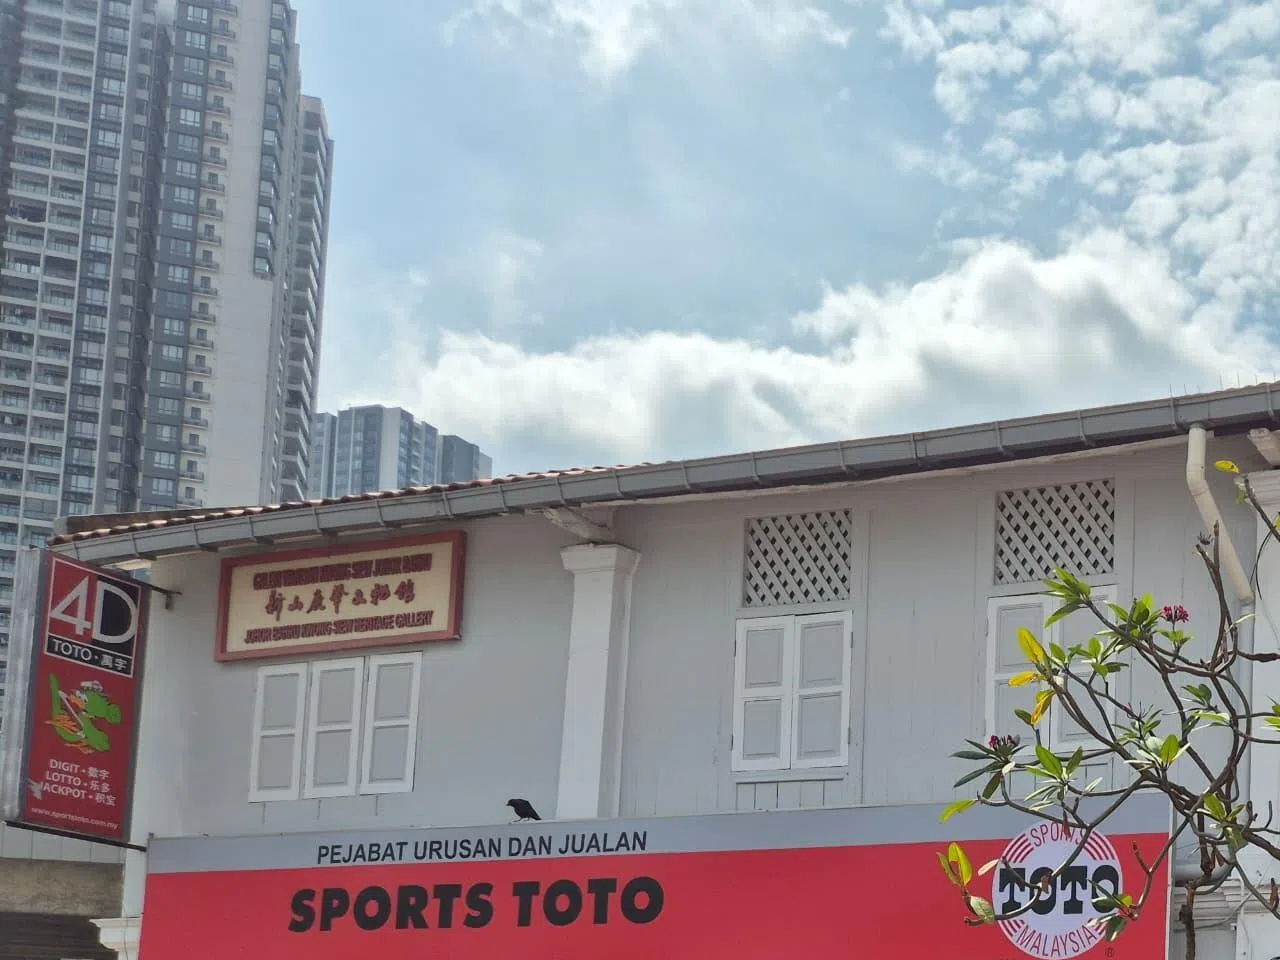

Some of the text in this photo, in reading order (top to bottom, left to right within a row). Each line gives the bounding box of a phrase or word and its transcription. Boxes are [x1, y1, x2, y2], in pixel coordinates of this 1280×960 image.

[49, 575, 138, 644] 4D
[395, 610, 434, 629] GALLERY
[52, 638, 92, 661] TOTO
[46, 770, 81, 786] LOTTO
[49, 759, 80, 774] DIGIT
[317, 831, 648, 865] PEJABAT URUSAN DAN JUALAN
[287, 875, 665, 933] SPORTS TOTO
[998, 865, 1119, 916] TOTO
[1015, 924, 1099, 958] MALAYSIA
